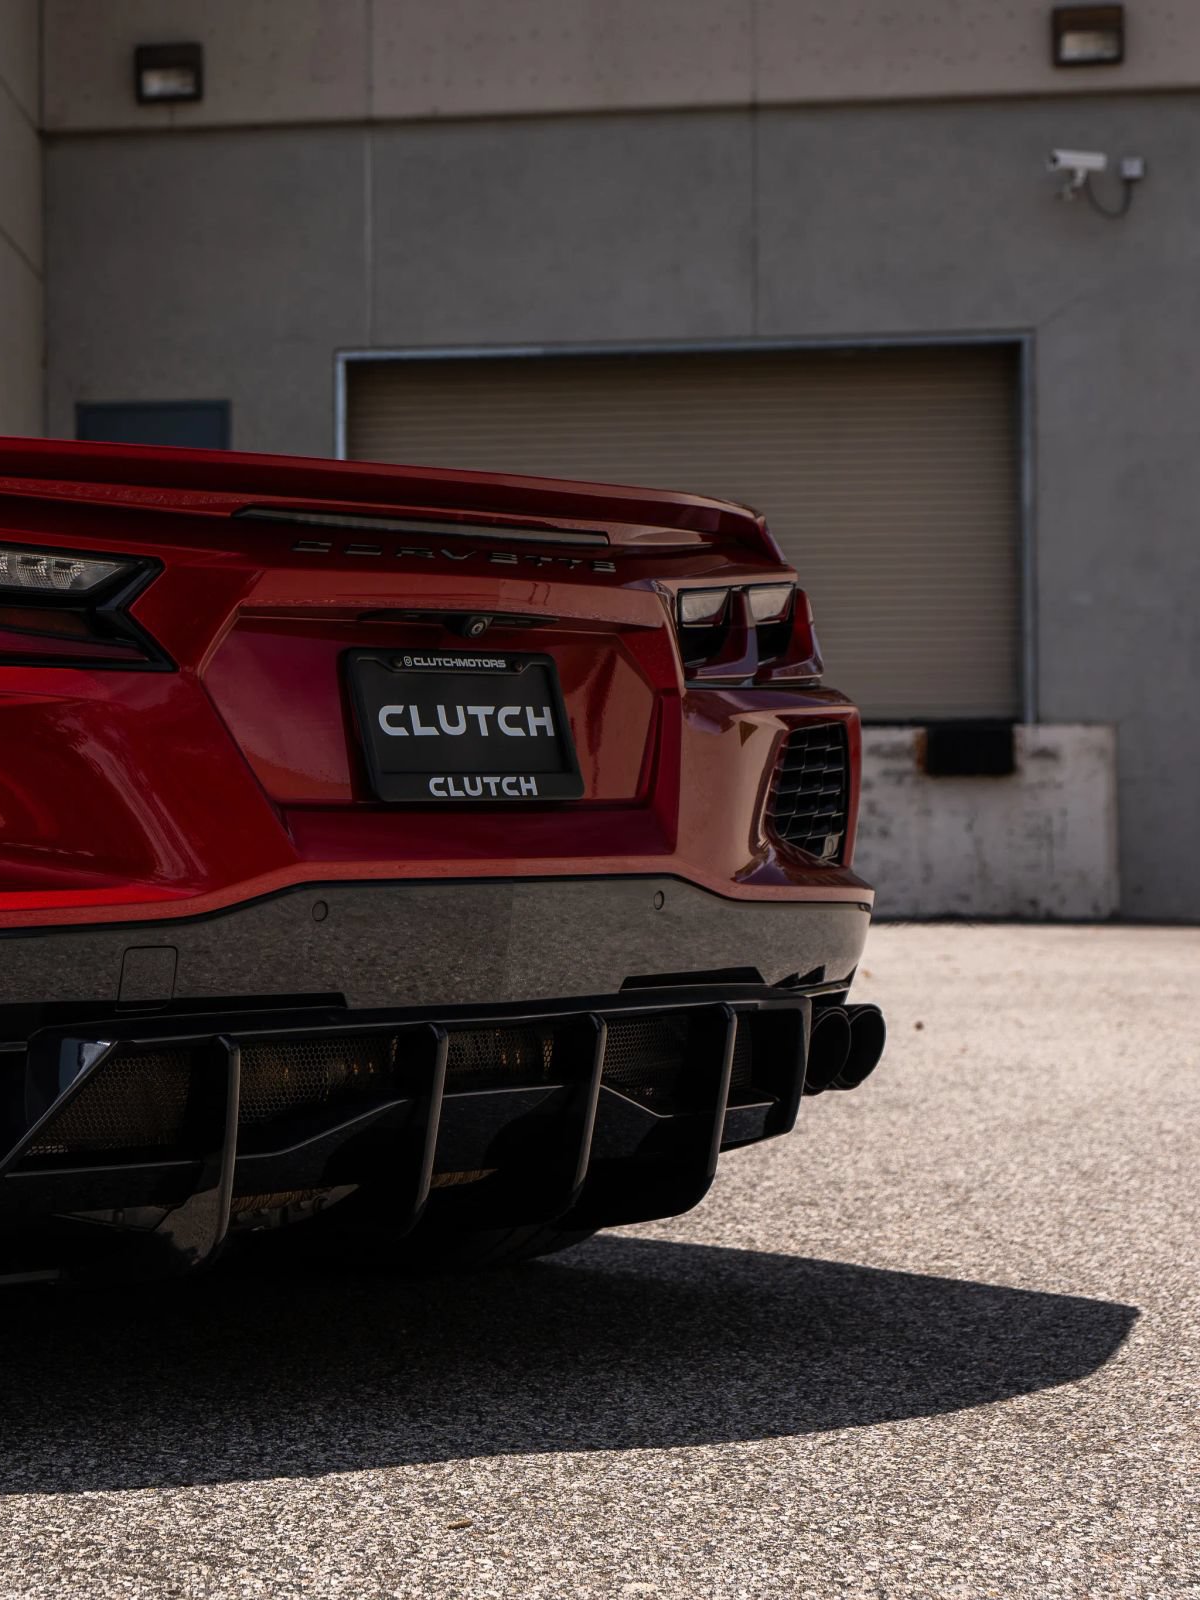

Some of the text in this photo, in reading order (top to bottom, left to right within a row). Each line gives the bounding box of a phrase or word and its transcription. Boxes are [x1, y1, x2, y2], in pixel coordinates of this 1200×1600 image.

[292, 540, 616, 572] CORVETTE
[413, 656, 507, 669] CLUTCHMOTORS
[378, 705, 555, 737] CLUTCH
[429, 776, 538, 797] CLUTCH
